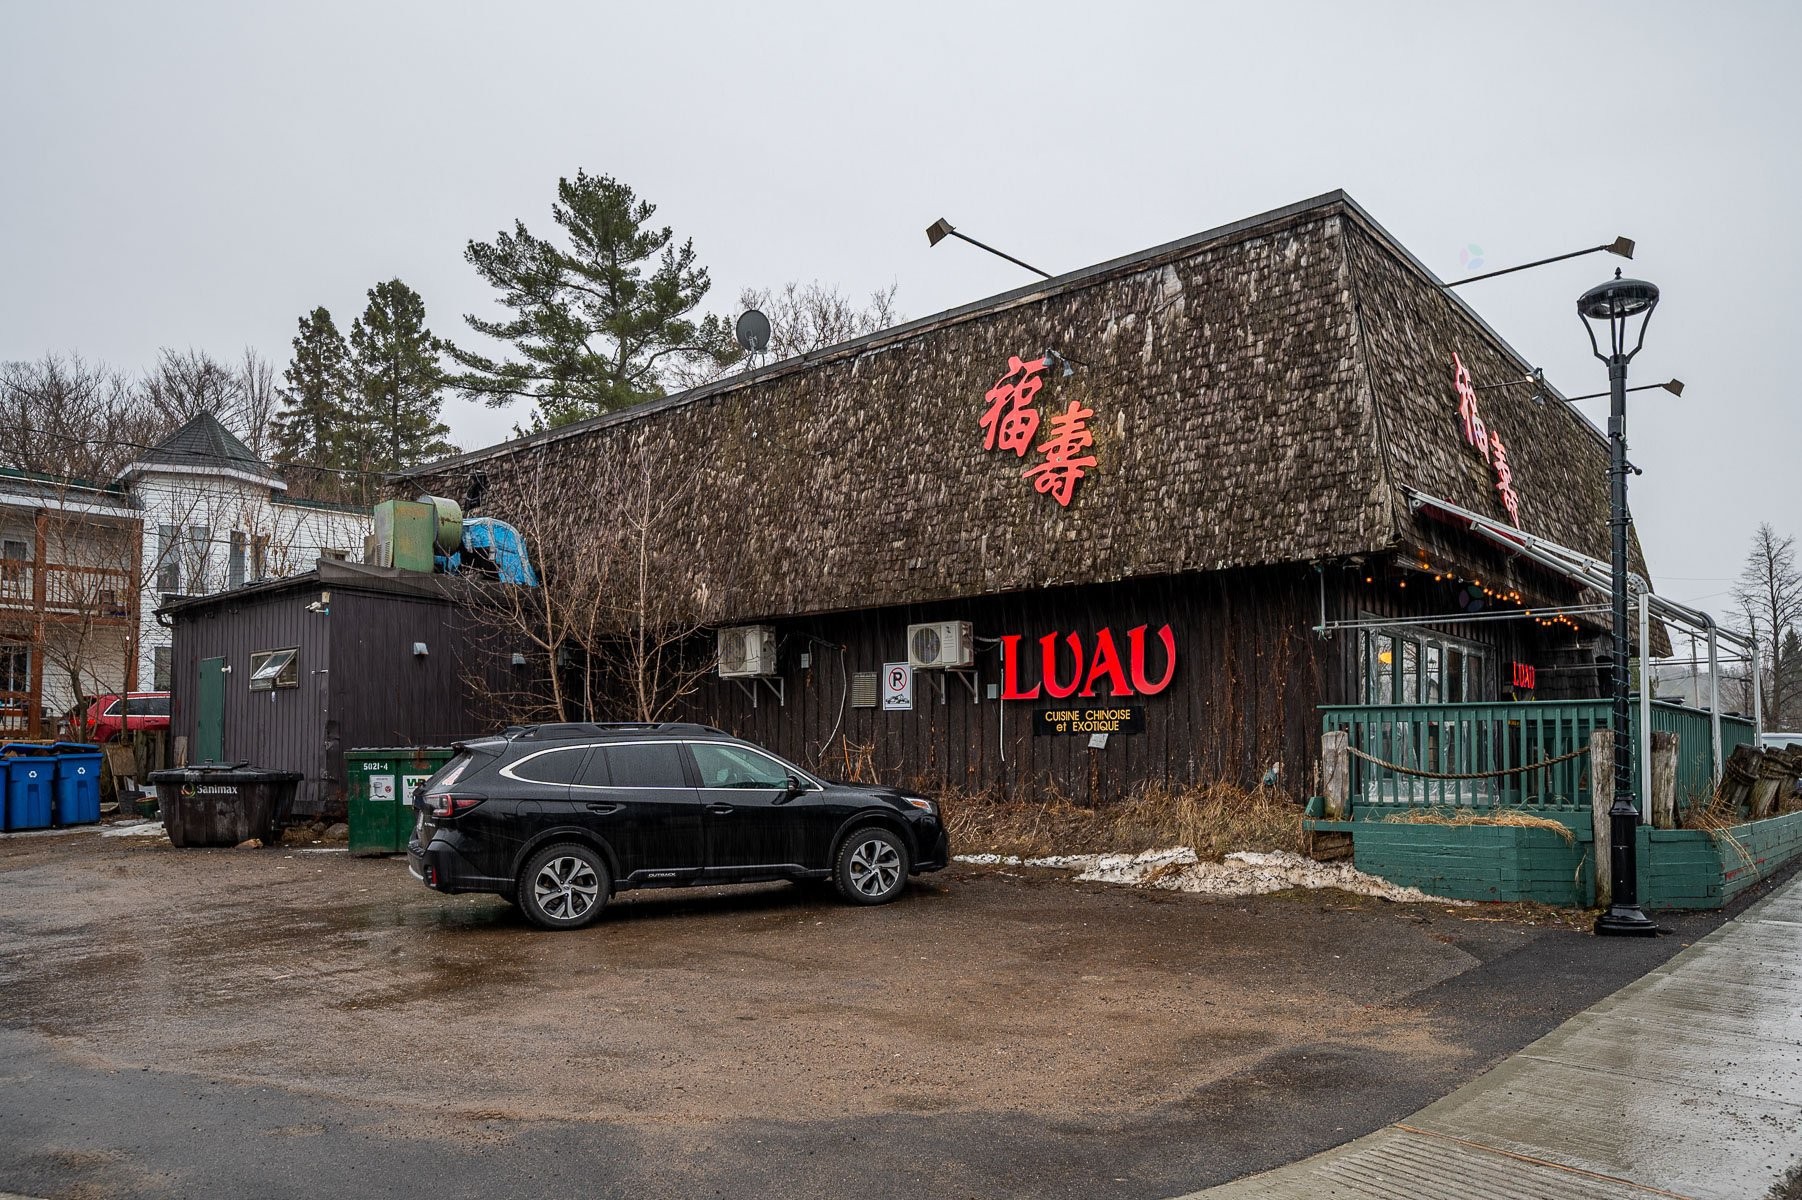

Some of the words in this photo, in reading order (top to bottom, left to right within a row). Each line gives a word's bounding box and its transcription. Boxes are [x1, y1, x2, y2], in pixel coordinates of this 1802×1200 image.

[1001, 624, 1176, 700] LUAU
[893, 672, 902, 686] P
[1513, 661, 1535, 689] LUAU
[1045, 710, 1080, 722] CUISINE
[1085, 709, 1131, 721] CHINOISE
[1056, 722, 1067, 732] et
[1073, 721, 1120, 732] EXOTIQUE
[363, 762, 389, 771] 5021-4
[196, 784, 238, 794] Sanimax
